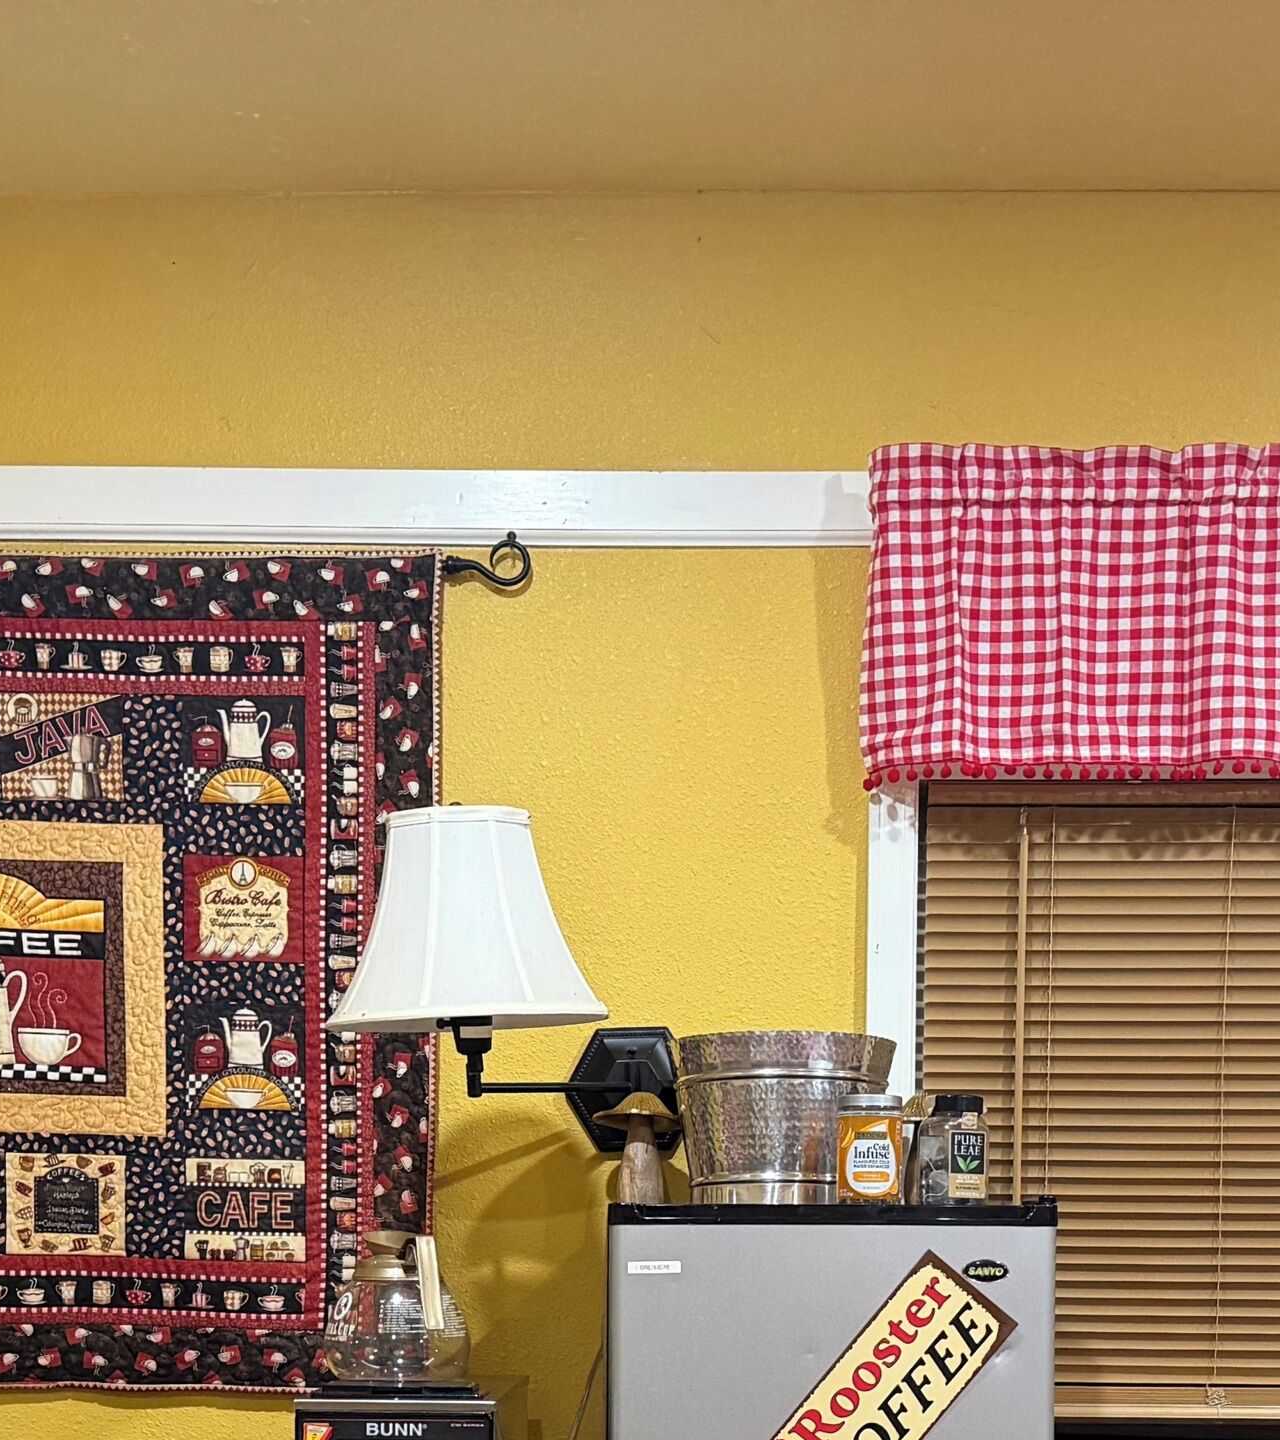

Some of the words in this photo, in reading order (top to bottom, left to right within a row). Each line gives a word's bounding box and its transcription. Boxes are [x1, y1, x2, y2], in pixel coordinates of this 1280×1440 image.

[14, 705, 111, 764] JAVA
[205, 888, 248, 905] Bistro
[954, 1135, 983, 1146] PURE
[854, 1146, 890, 1159] Infuse
[873, 1143, 890, 1151] Cold
[954, 1146, 981, 1155] LEAF
[197, 1191, 294, 1229] CAFE
[968, 1266, 1004, 1277] SANYO
